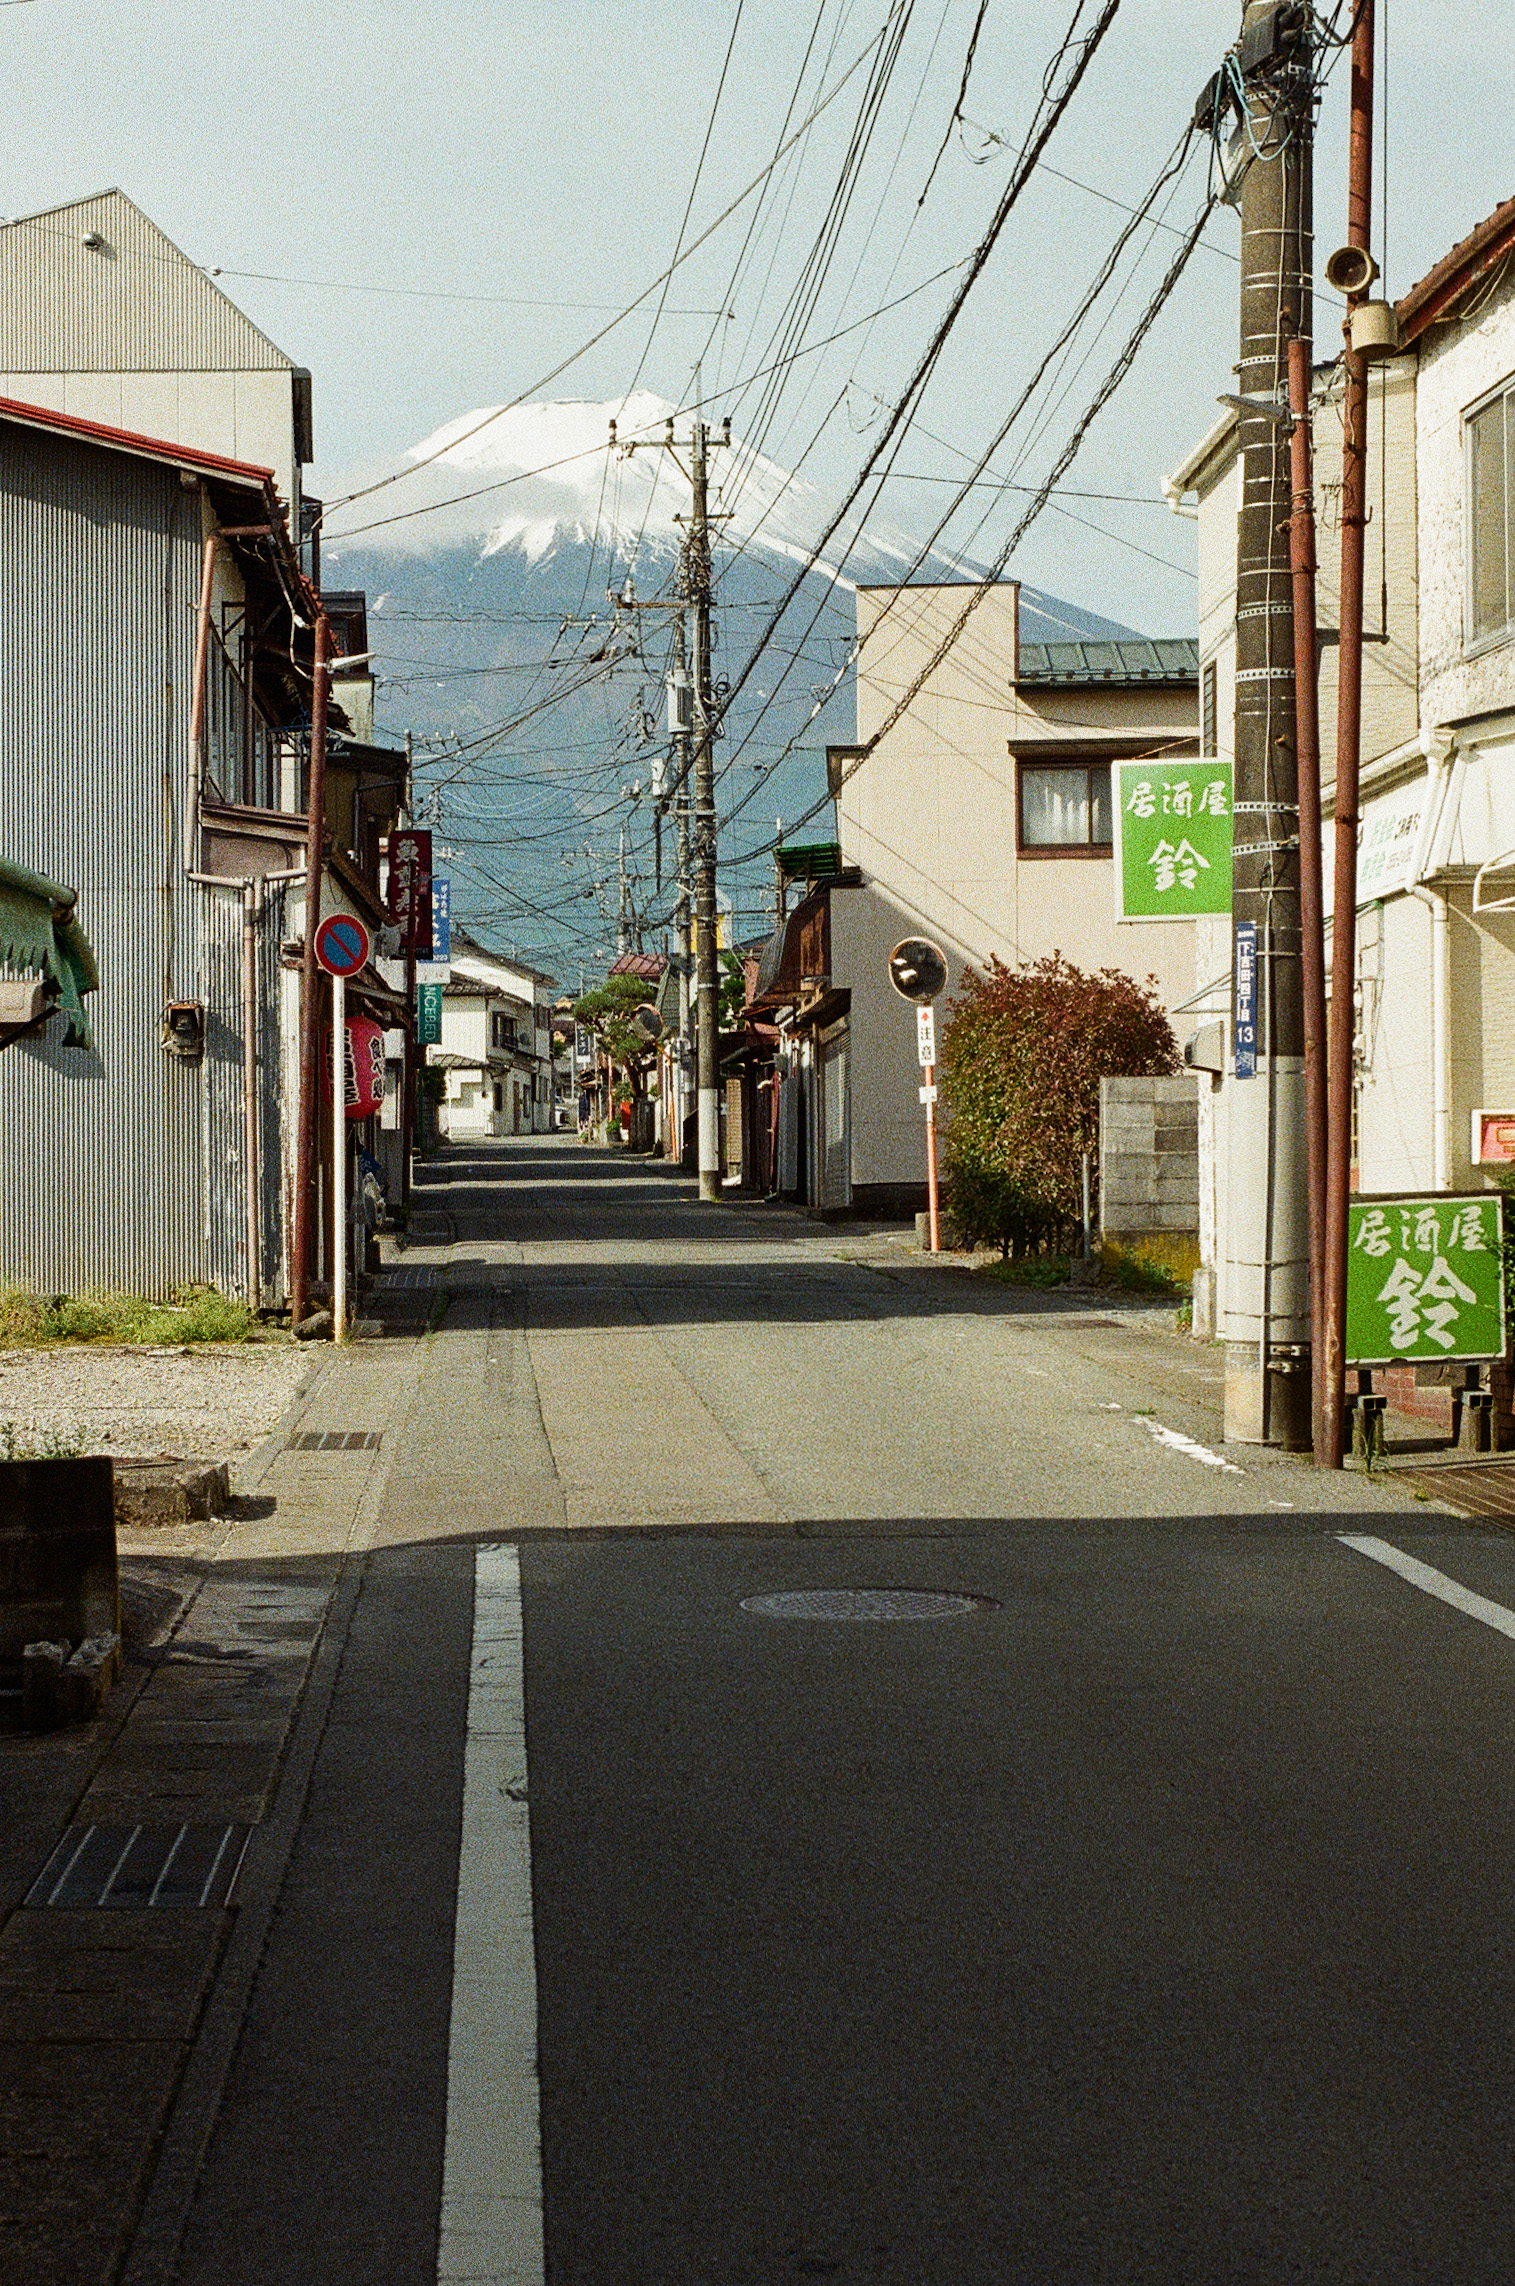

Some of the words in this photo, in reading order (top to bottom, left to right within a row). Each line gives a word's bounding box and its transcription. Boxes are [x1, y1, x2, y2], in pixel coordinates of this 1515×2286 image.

[1127, 781, 1229, 818] 居酒屋
[1147, 838, 1211, 892] 鈴
[920, 1026, 932, 1061] 注意
[1237, 1026, 1254, 1043] 13
[1353, 1205, 1488, 1257] 居酒屋
[1376, 1256, 1477, 1350] 鈴
